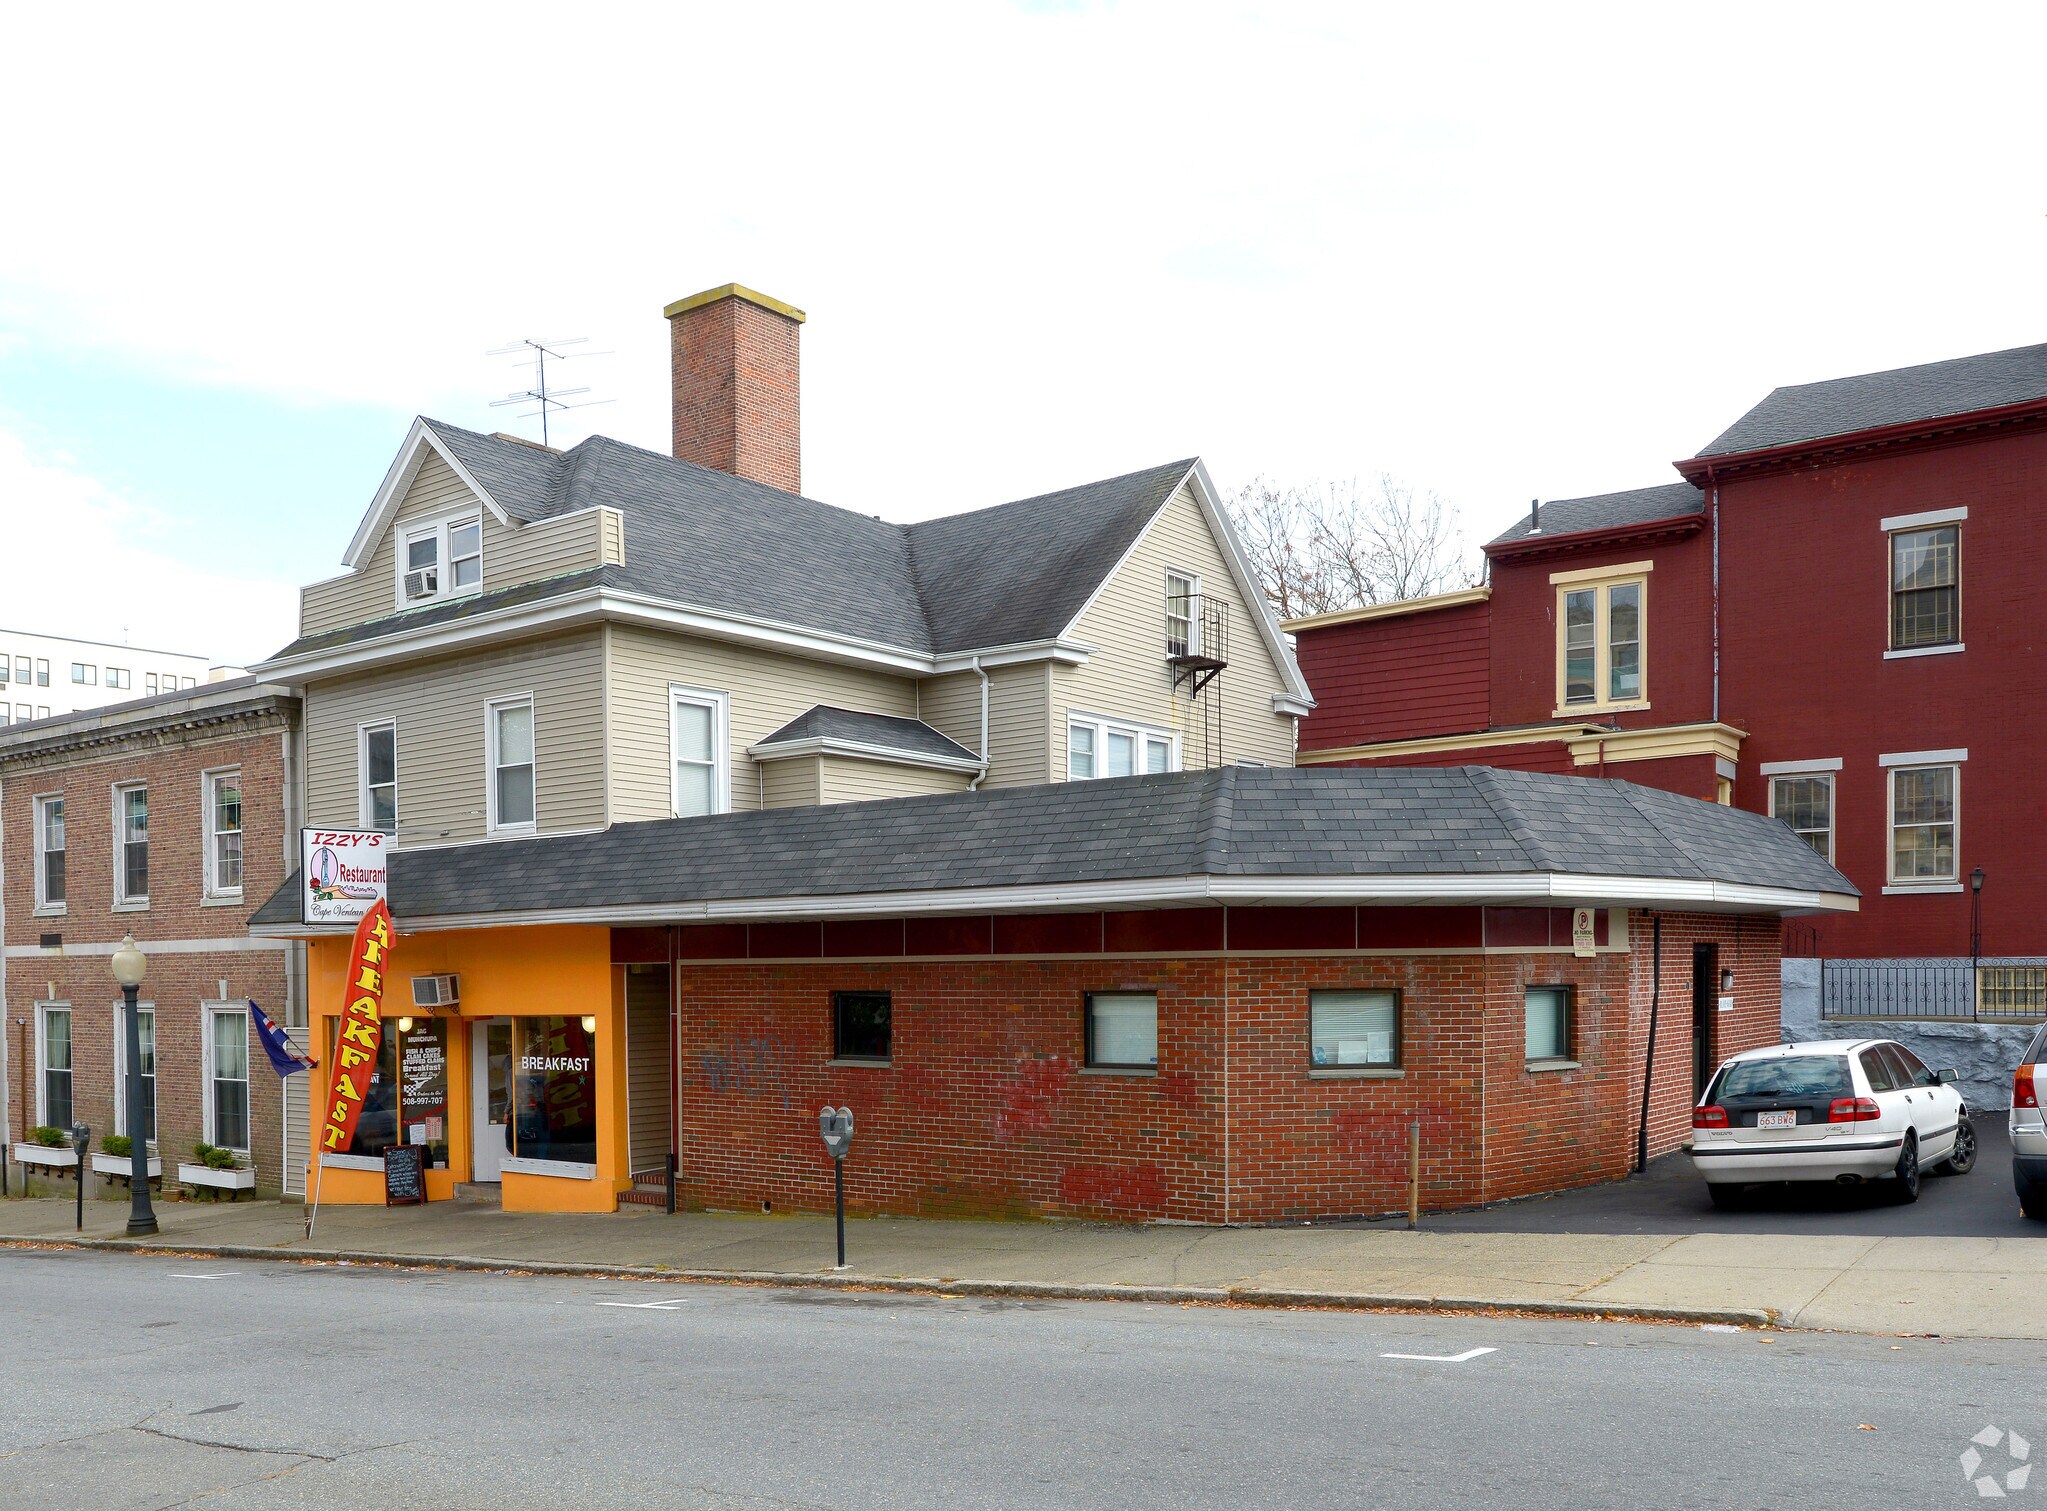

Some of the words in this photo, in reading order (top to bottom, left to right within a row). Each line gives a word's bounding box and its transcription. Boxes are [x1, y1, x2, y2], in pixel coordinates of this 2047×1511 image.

[311, 832, 383, 847] IZZY'S
[340, 863, 386, 883] Restaurant
[311, 903, 331, 920] Cape
[333, 903, 364, 917] Verdean
[403, 1064, 441, 1072] Breakfast
[521, 1056, 590, 1072] BREAKFAST
[1759, 1116, 1776, 1126] 663
[1777, 1115, 1794, 1125] BW6
